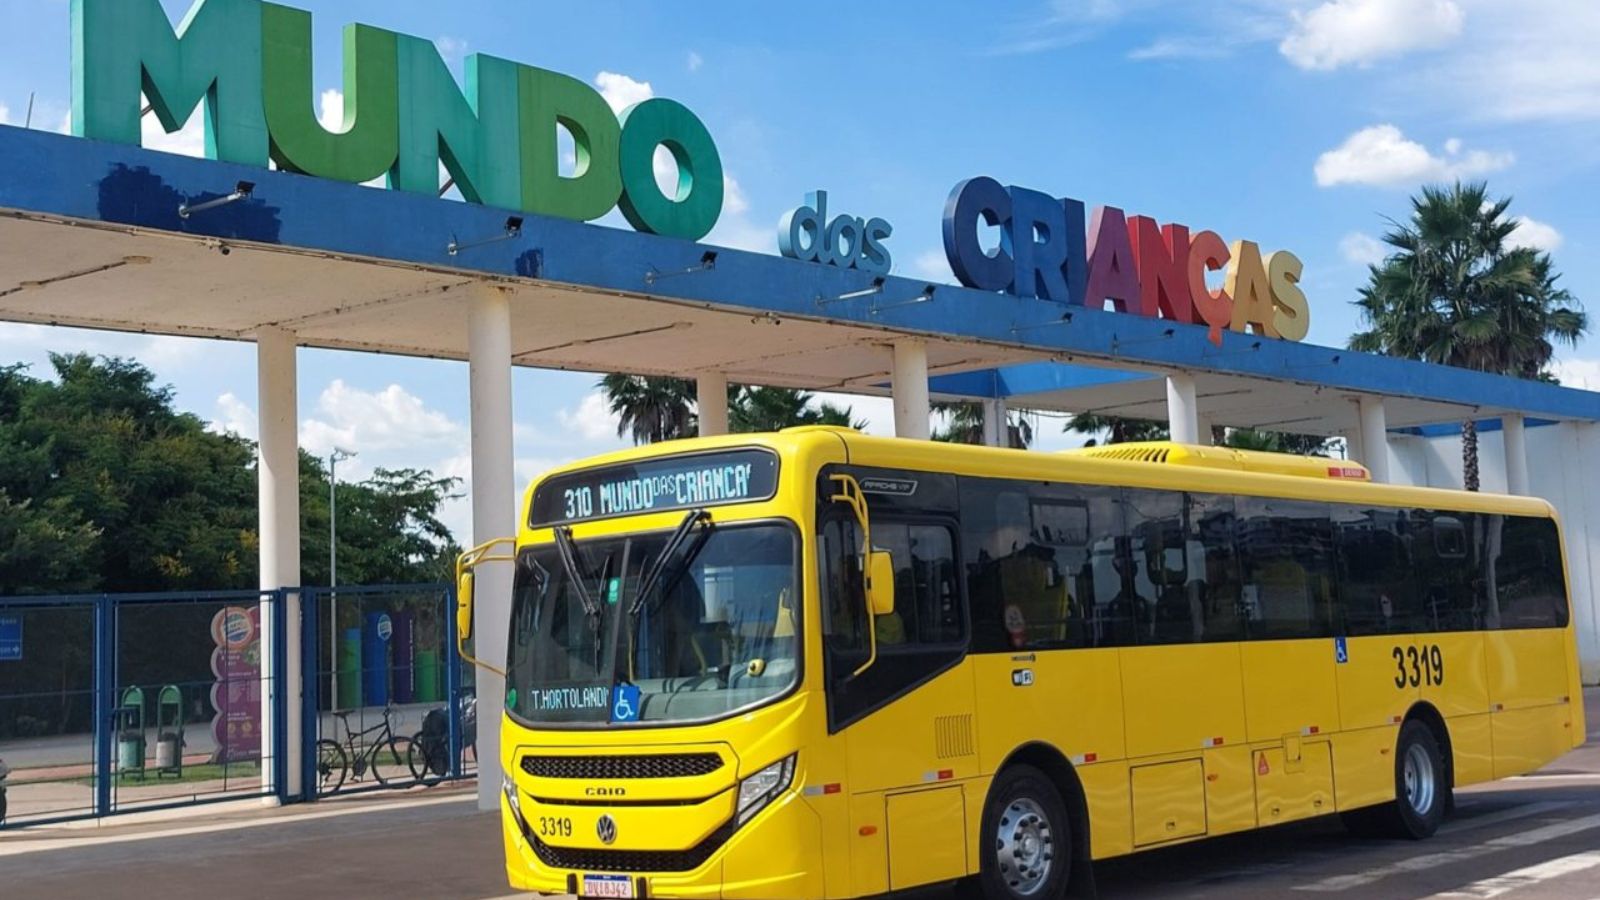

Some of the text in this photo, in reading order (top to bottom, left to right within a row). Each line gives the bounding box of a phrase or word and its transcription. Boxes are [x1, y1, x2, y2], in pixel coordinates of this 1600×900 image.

[70, 0, 1310, 346] MUNDO das CRIANÇAS
[564, 486, 592, 518] 310
[600, 478, 653, 514] MUNDO
[653, 474, 676, 496] DAS
[1392, 644, 1443, 689] 3319
[539, 817, 572, 837] 3319
